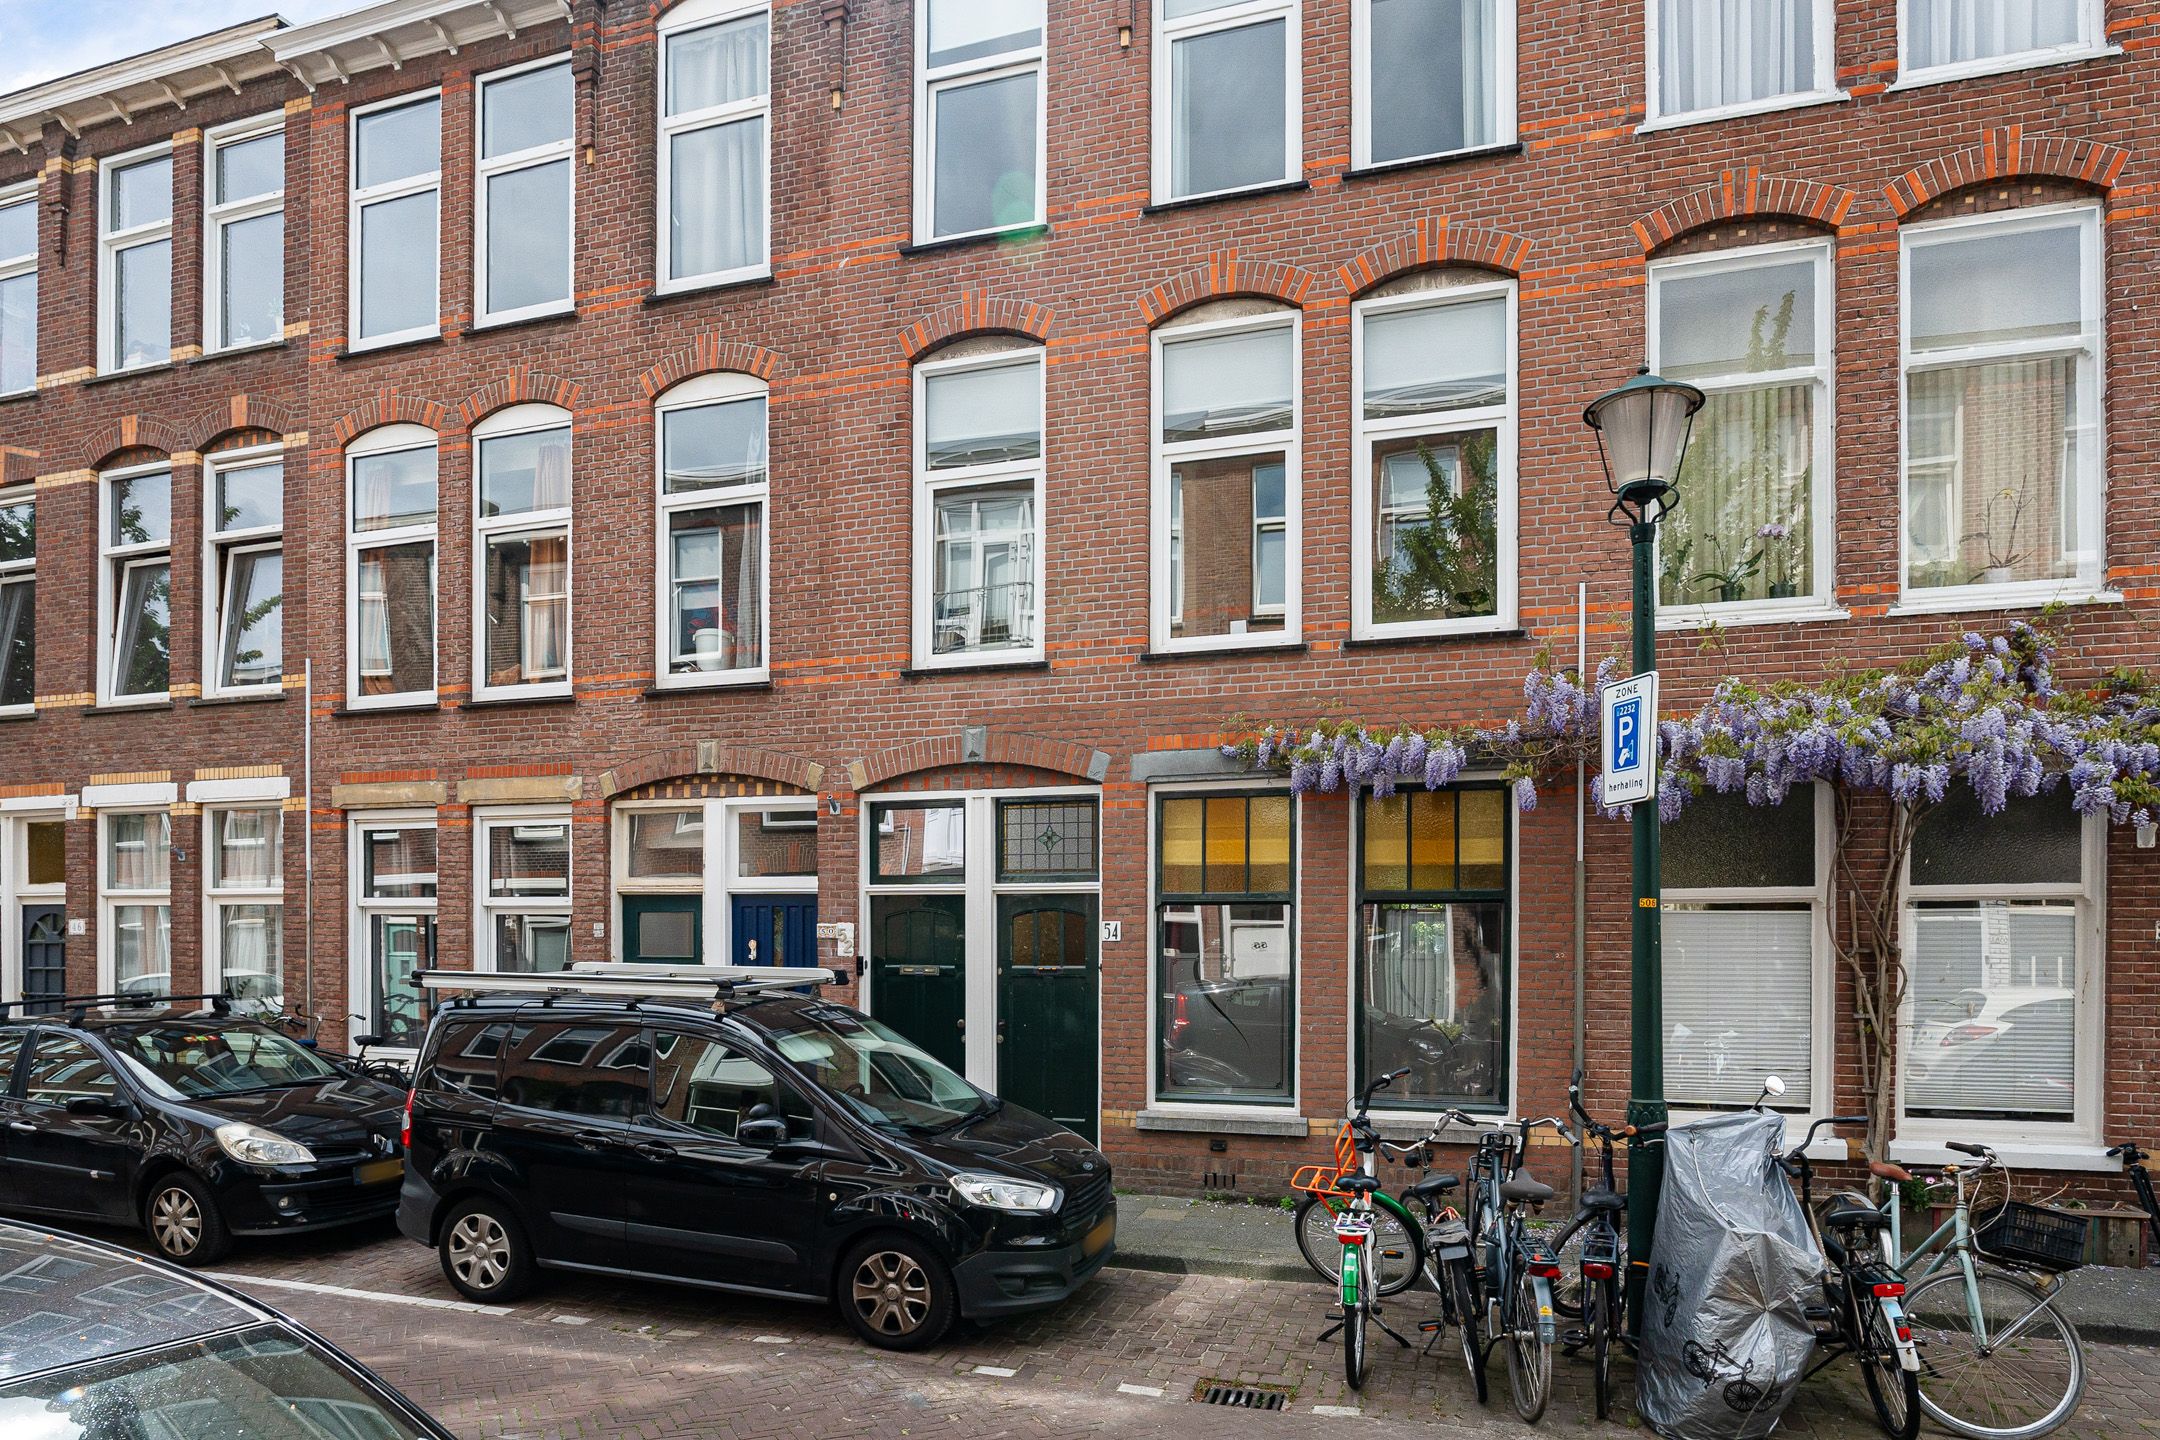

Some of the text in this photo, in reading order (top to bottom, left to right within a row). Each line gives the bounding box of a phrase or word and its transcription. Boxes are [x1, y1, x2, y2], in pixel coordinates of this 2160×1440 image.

[1616, 684, 1639, 699] ZONE
[1620, 704, 1636, 715] 2232
[1619, 716, 1634, 748] P
[1608, 778, 1643, 792] herhaling
[1104, 923, 1118, 940] 54
[838, 928, 853, 954] 52
